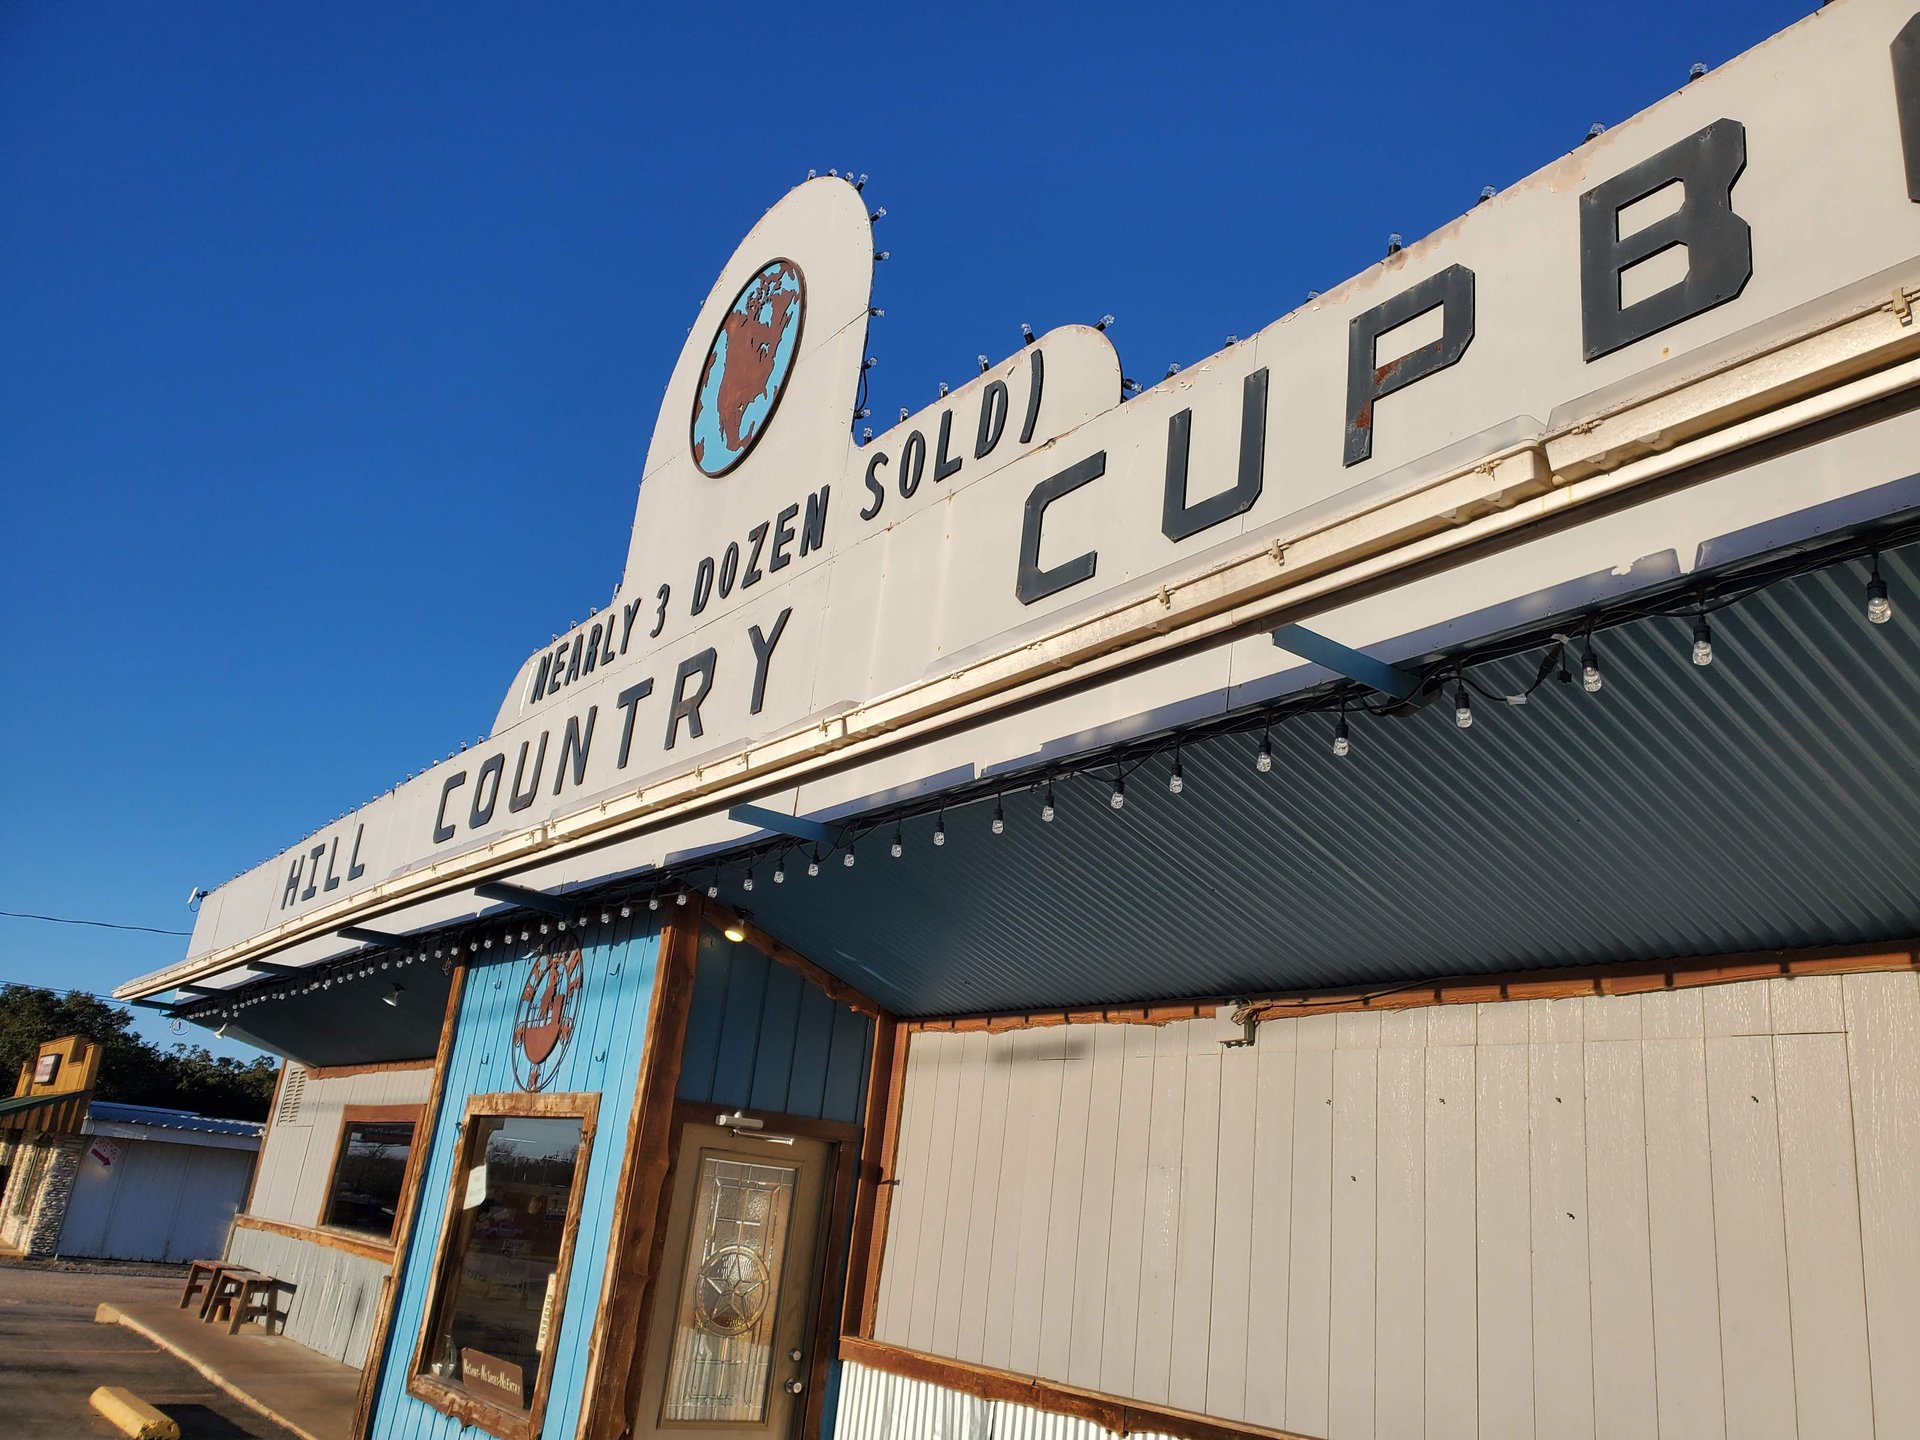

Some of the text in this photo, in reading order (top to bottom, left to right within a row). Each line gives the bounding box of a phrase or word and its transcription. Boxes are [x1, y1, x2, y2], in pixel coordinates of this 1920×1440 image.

[281, 12, 1920, 911] HILL COUNTRY CUPB
[650, 584, 671, 639] 3
[691, 484, 831, 617] DOZEN
